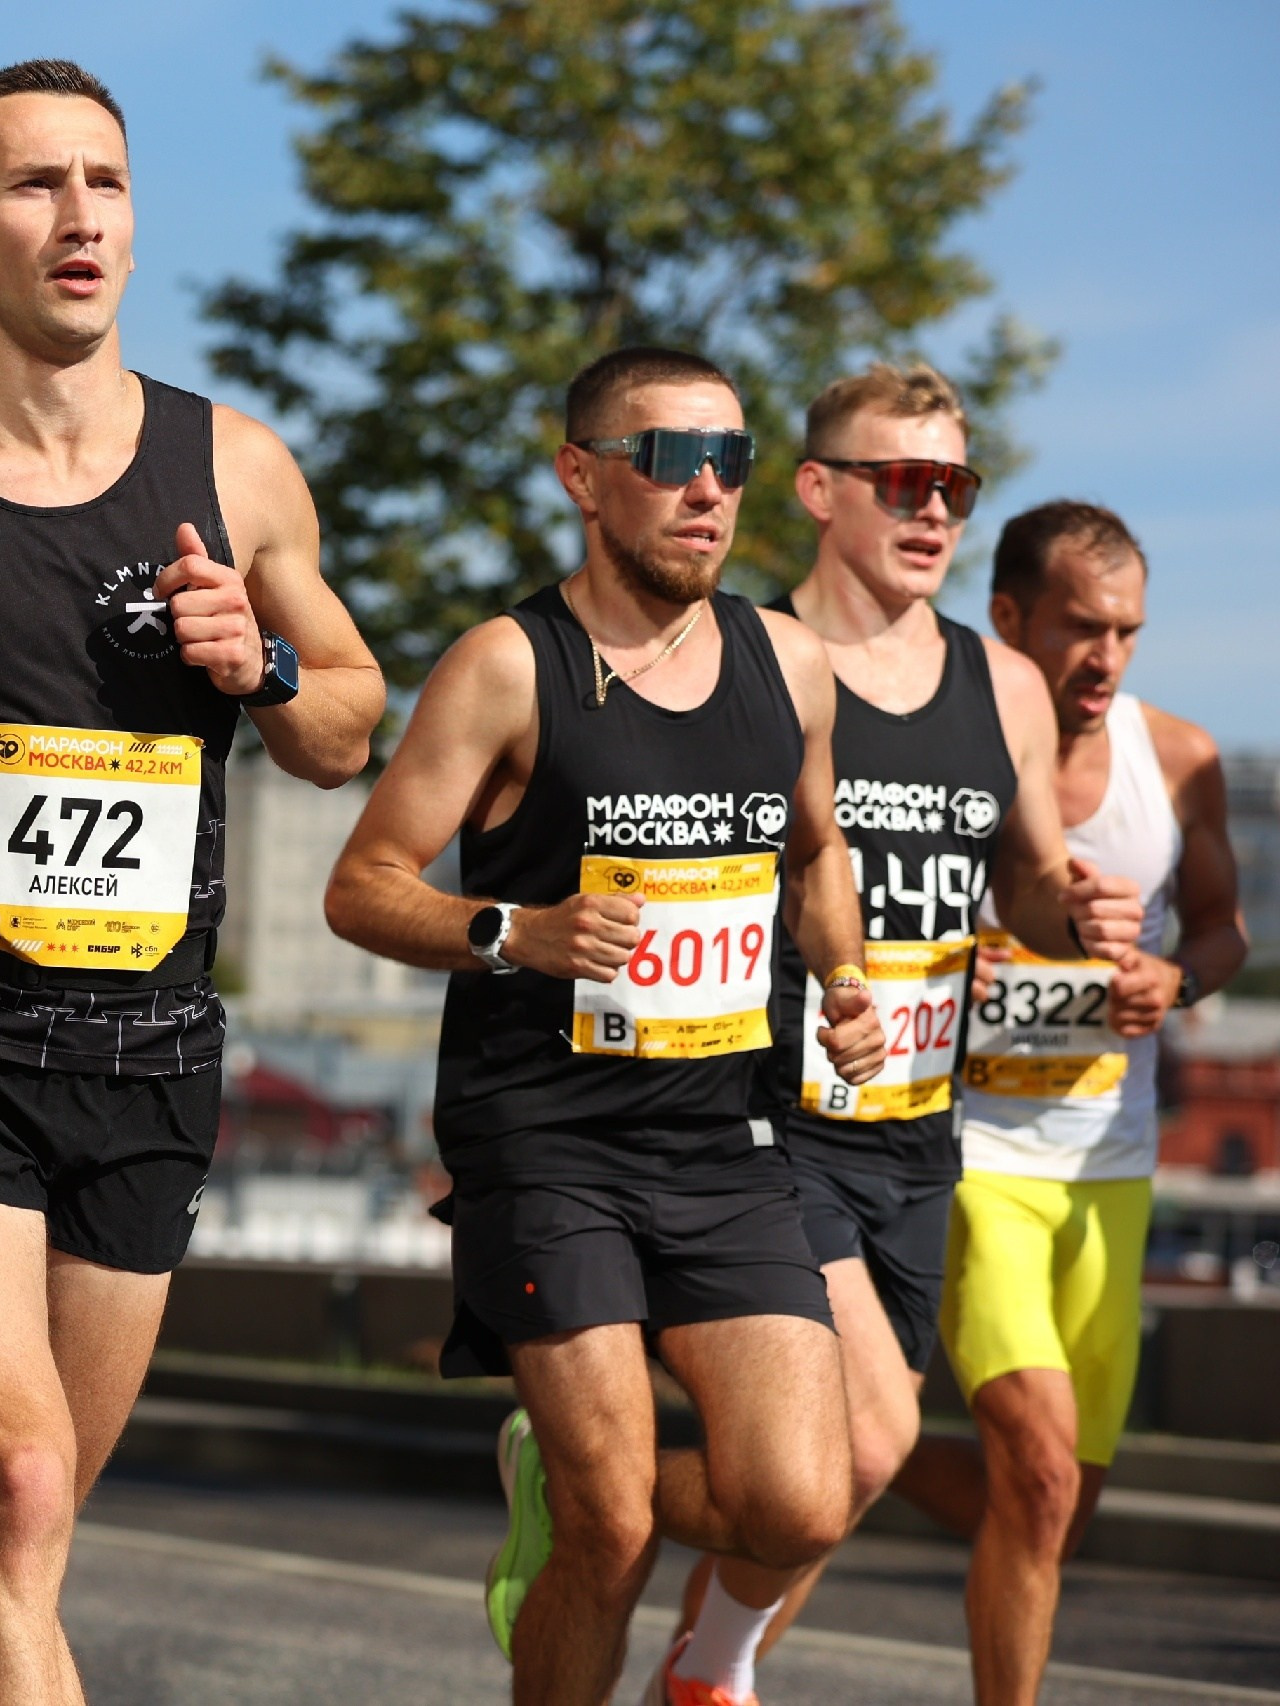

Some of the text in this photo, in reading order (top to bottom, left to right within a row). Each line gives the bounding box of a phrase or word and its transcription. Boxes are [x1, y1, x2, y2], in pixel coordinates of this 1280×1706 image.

[29, 735, 124, 756] МАРАФОН
[28, 753, 183, 775] МОСКВА 42,2 КМ
[586, 793, 734, 821] МАРАФОН
[833, 779, 946, 810] АРАФОН
[7, 794, 144, 870] 472
[833, 804, 925, 832] ОСКВА
[588, 820, 711, 846] МОСКВА
[28, 874, 119, 897] АЛЕКСЕЙ
[643, 867, 719, 880] МАРАФОН
[644, 882, 709, 896] МОСКВА
[744, 877, 761, 889] КМ
[87, 945, 121, 954] СИБУР
[628, 923, 765, 987] 6019
[978, 980, 1107, 1026] 8322
[603, 1013, 626, 1042] B
[888, 998, 956, 1056] 202
[970, 1057, 990, 1086] B
[829, 1084, 849, 1111] B
